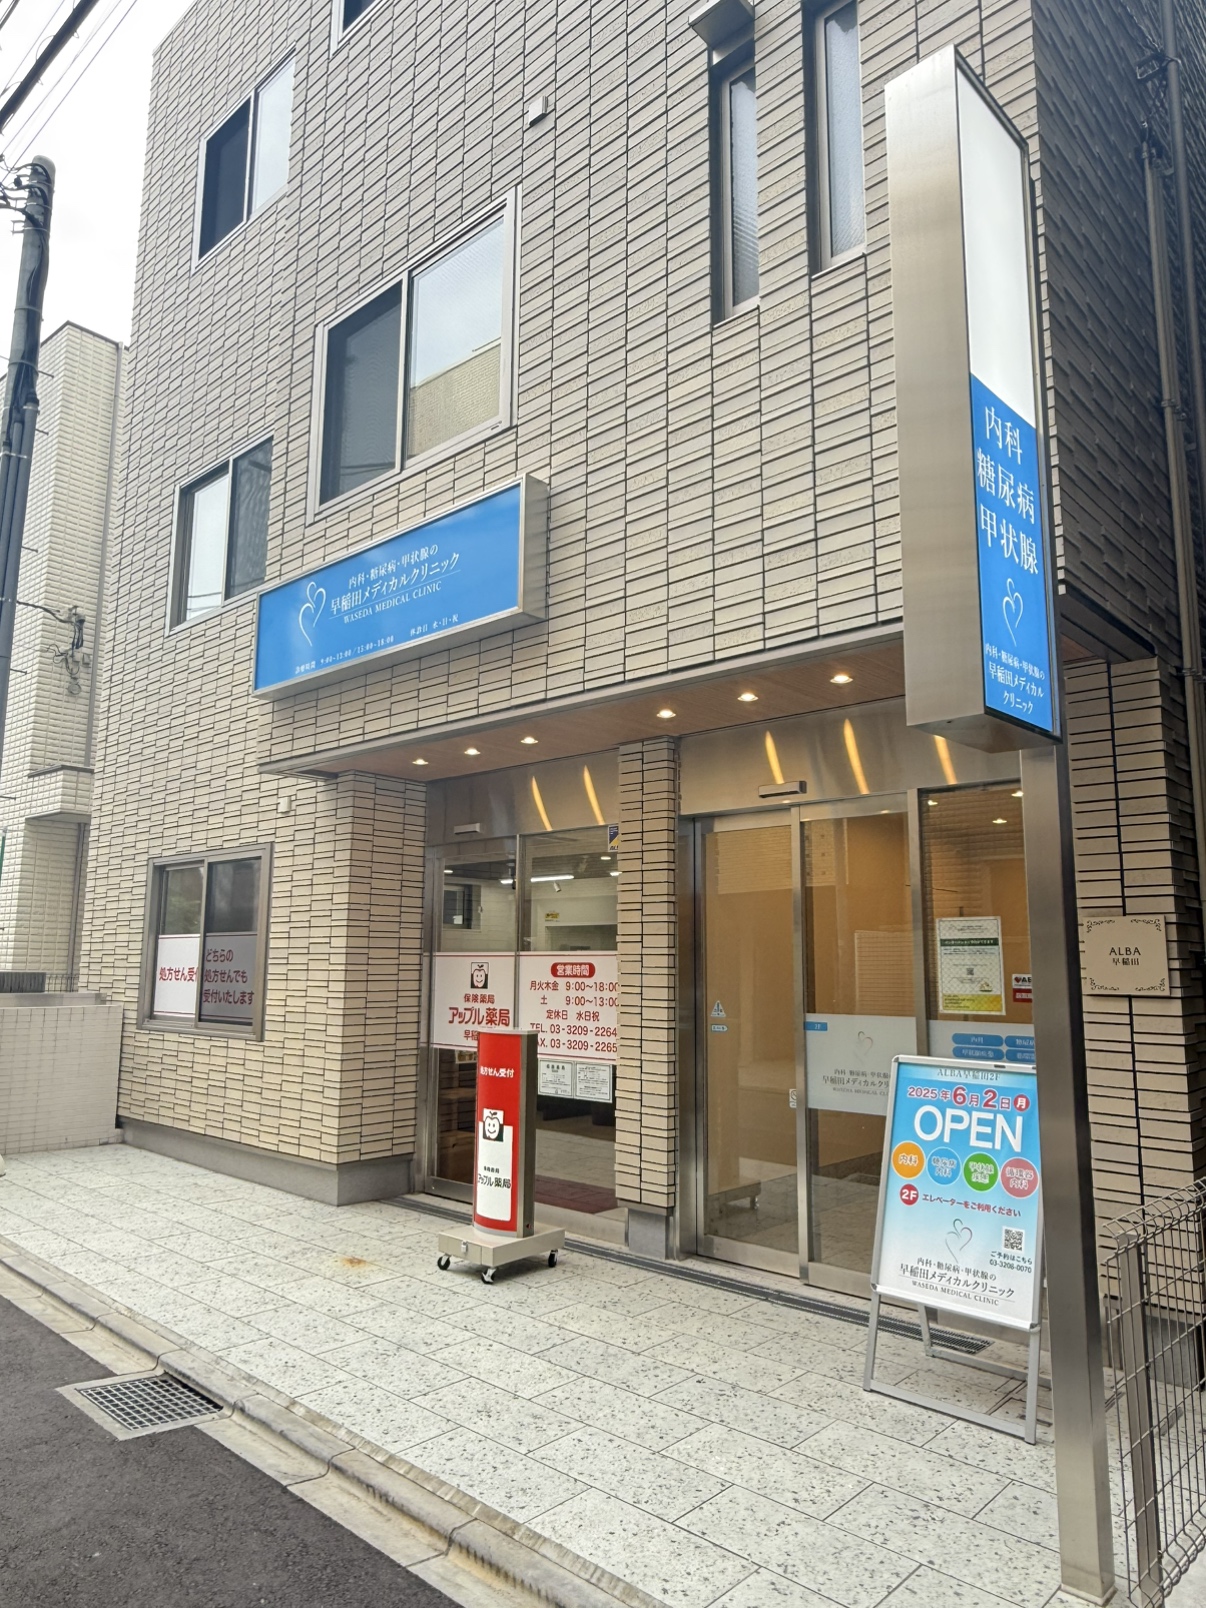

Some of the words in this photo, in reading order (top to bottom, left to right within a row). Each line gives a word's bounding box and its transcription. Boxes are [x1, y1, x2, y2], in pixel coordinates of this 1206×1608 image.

[985, 406, 1022, 465] 内科
[977, 447, 1034, 524] 糖尿病
[980, 503, 1038, 574] 甲状腺
[330, 552, 459, 615] 早稲田メディカルクリニック
[344, 607, 372, 623] WASEDA
[375, 593, 410, 613] MEDICAL
[412, 580, 441, 599] CLINIC
[989, 661, 1044, 697] 早稲田メディカル
[1003, 690, 1033, 714] クリニック
[206, 948, 233, 962] どちらの
[1109, 947, 1141, 956] ALBA
[204, 969, 247, 983] 処方せんでも
[556, 964, 590, 976] 営業時間
[530, 980, 559, 991] 月火木金
[203, 989, 254, 1005] 受付いたします
[463, 993, 495, 1004] 保険薬局
[540, 994, 548, 1005] 土
[448, 1006, 510, 1027] アップル薬局
[546, 1009, 568, 1020] 定休日
[576, 1010, 600, 1021] 水日祝
[463, 1029, 479, 1041] 早稲
[822, 1075, 889, 1089] 早稲田メディカルクリ
[914, 1105, 1023, 1153] OPEN
[898, 1152, 919, 1167] 内科
[901, 1189, 918, 1201] 2F
[922, 1193, 1022, 1217] エレベーターをご利用ください
[990, 1250, 1033, 1266] ご予約はこちら
[900, 1263, 1015, 1299] 早稲田メディカルクリニック
[911, 1280, 939, 1292] WASEDA
[940, 1287, 972, 1300] MEDICAL
[973, 1294, 999, 1306] CLINIC
